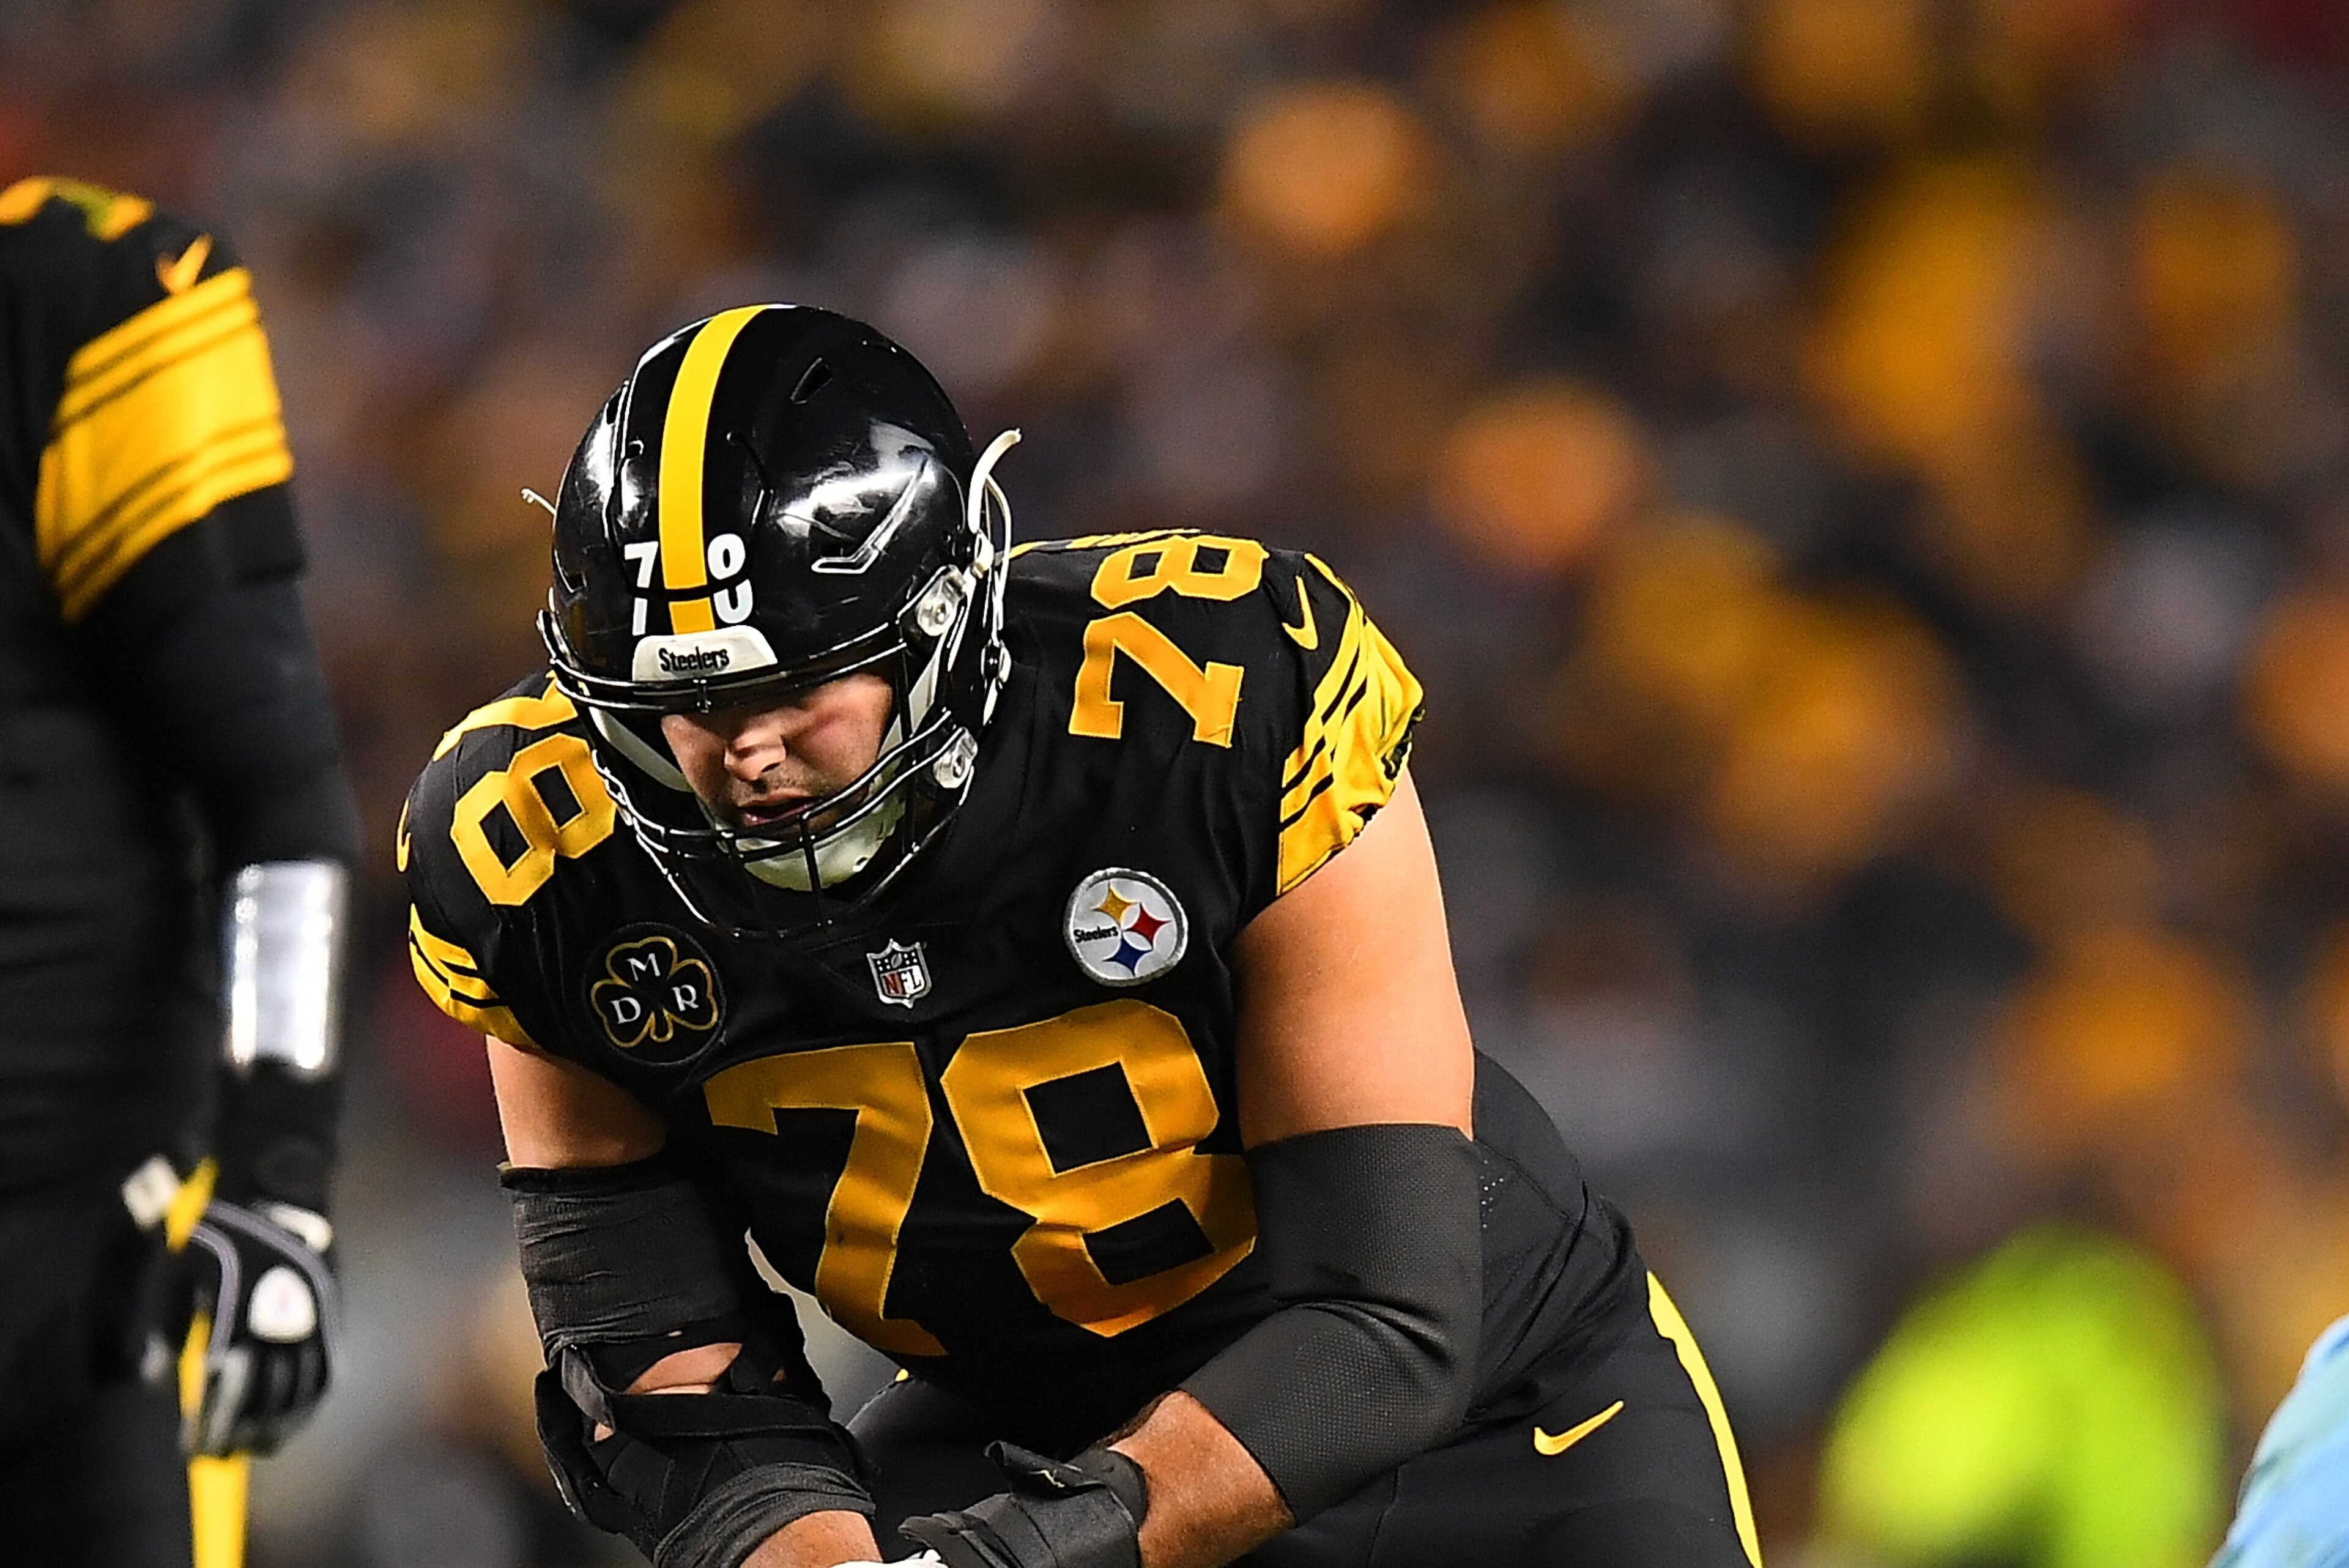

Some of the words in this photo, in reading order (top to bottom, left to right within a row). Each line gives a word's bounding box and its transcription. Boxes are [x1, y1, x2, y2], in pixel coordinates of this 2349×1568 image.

[1069, 535, 1270, 748] 78
[659, 646, 730, 672] Steelers
[1074, 926, 1119, 943] Steelers
[883, 967, 922, 995] NFL
[702, 998, 1259, 1356] 78
